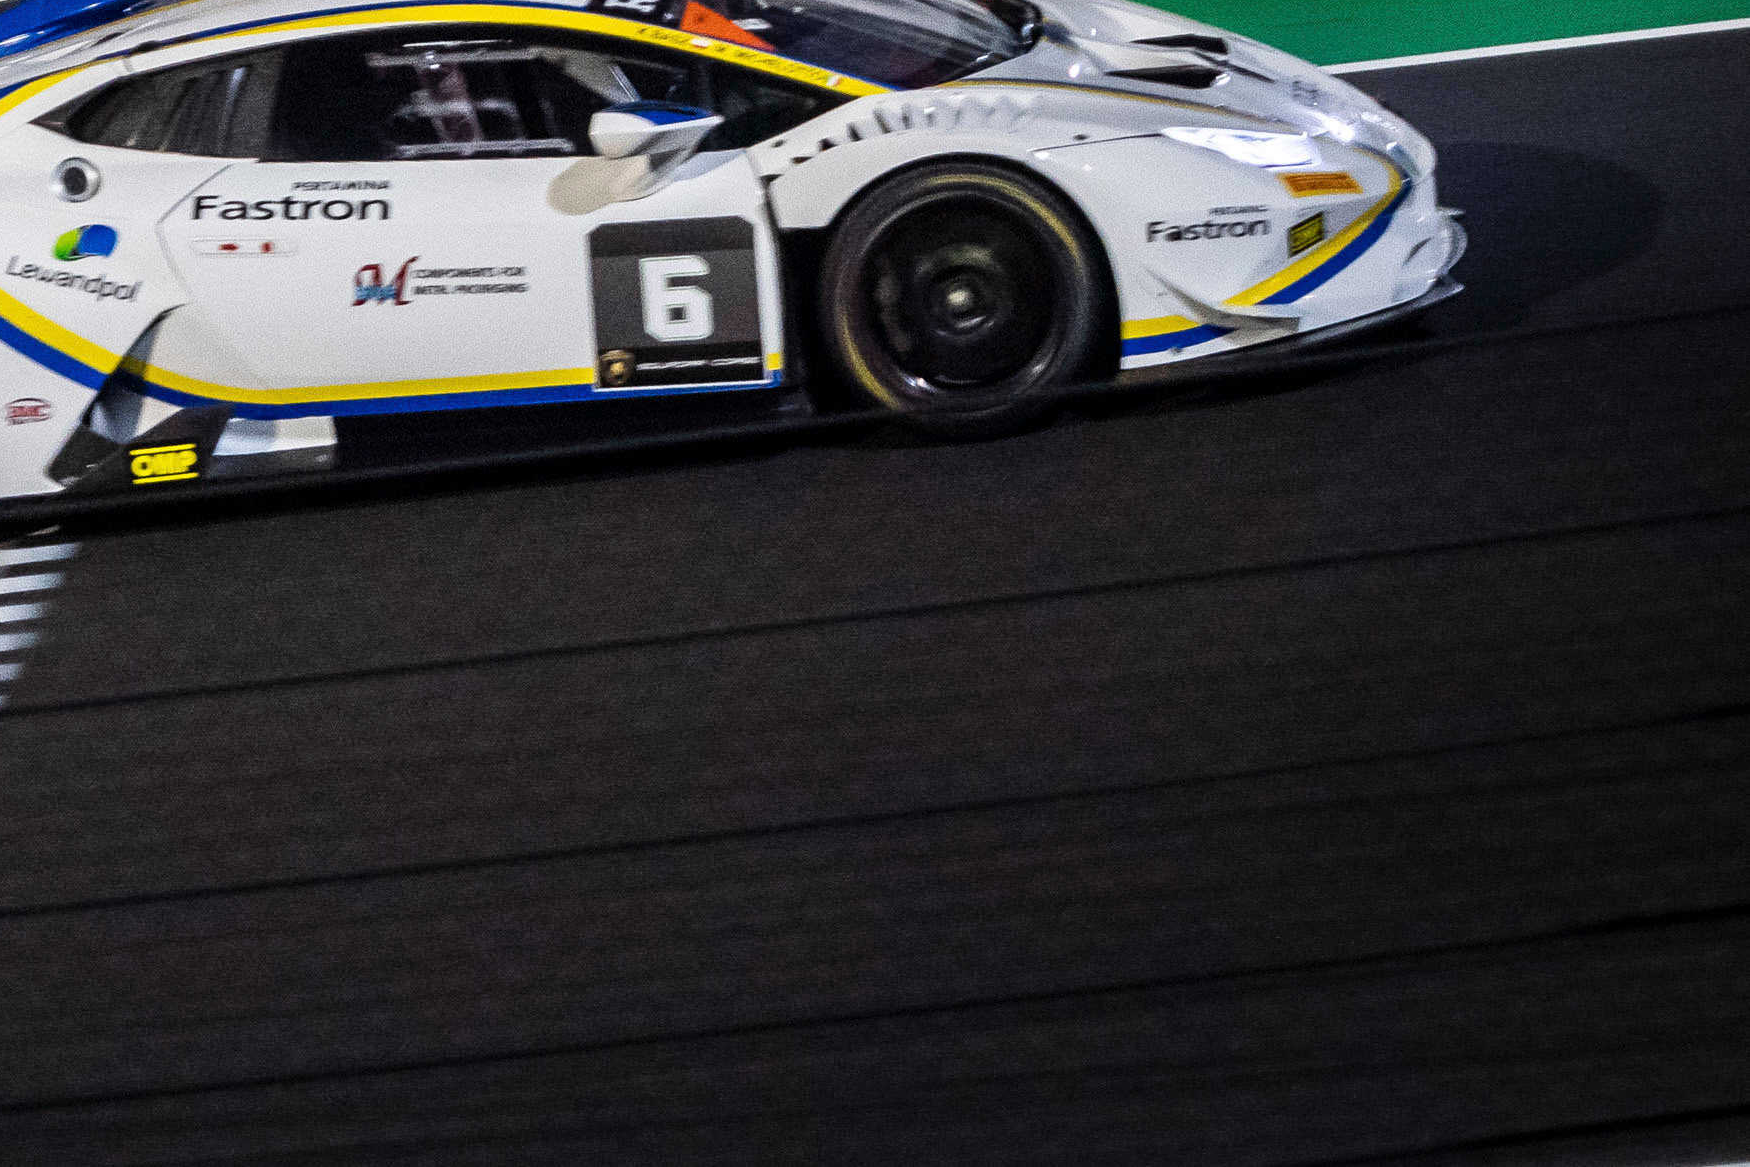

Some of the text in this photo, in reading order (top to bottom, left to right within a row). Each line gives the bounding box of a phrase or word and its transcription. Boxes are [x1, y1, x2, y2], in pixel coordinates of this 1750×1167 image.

[192, 195, 391, 221] Fastron
[1146, 218, 1271, 243] Fastron
[6, 254, 143, 302] Lewandpol
[639, 254, 714, 342] 6
